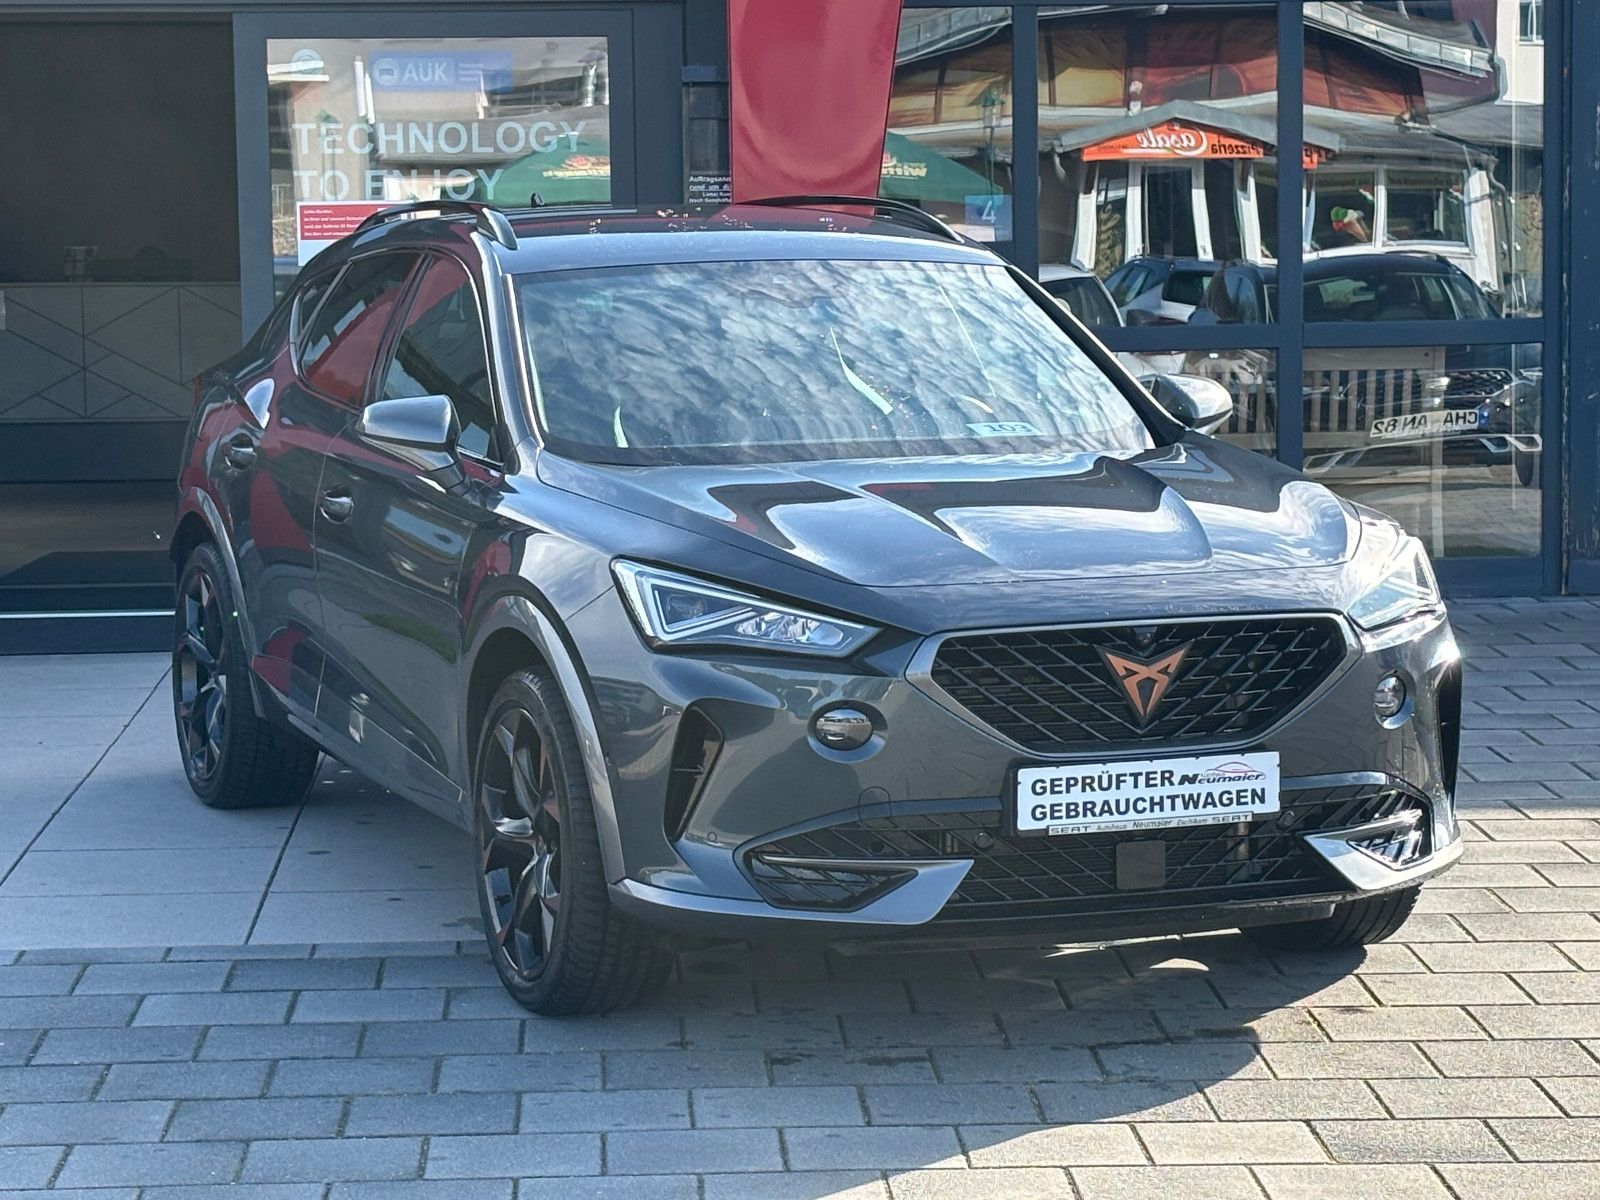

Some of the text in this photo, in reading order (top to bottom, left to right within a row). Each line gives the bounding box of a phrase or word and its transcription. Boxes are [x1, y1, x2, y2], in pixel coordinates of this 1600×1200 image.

[291, 120, 586, 155] TECHNOLOGY
[292, 169, 350, 201] TO
[365, 168, 504, 201] ENJOY
[981, 200, 997, 224] 4
[1031, 769, 1265, 796] GEPRÜFTER Neumaier
[1031, 787, 1267, 822] GEBRAUCHTWAGEN
[1050, 825, 1092, 834] SEAT
[1132, 819, 1173, 829] Neumaier
[1211, 813, 1250, 823] SEAT
